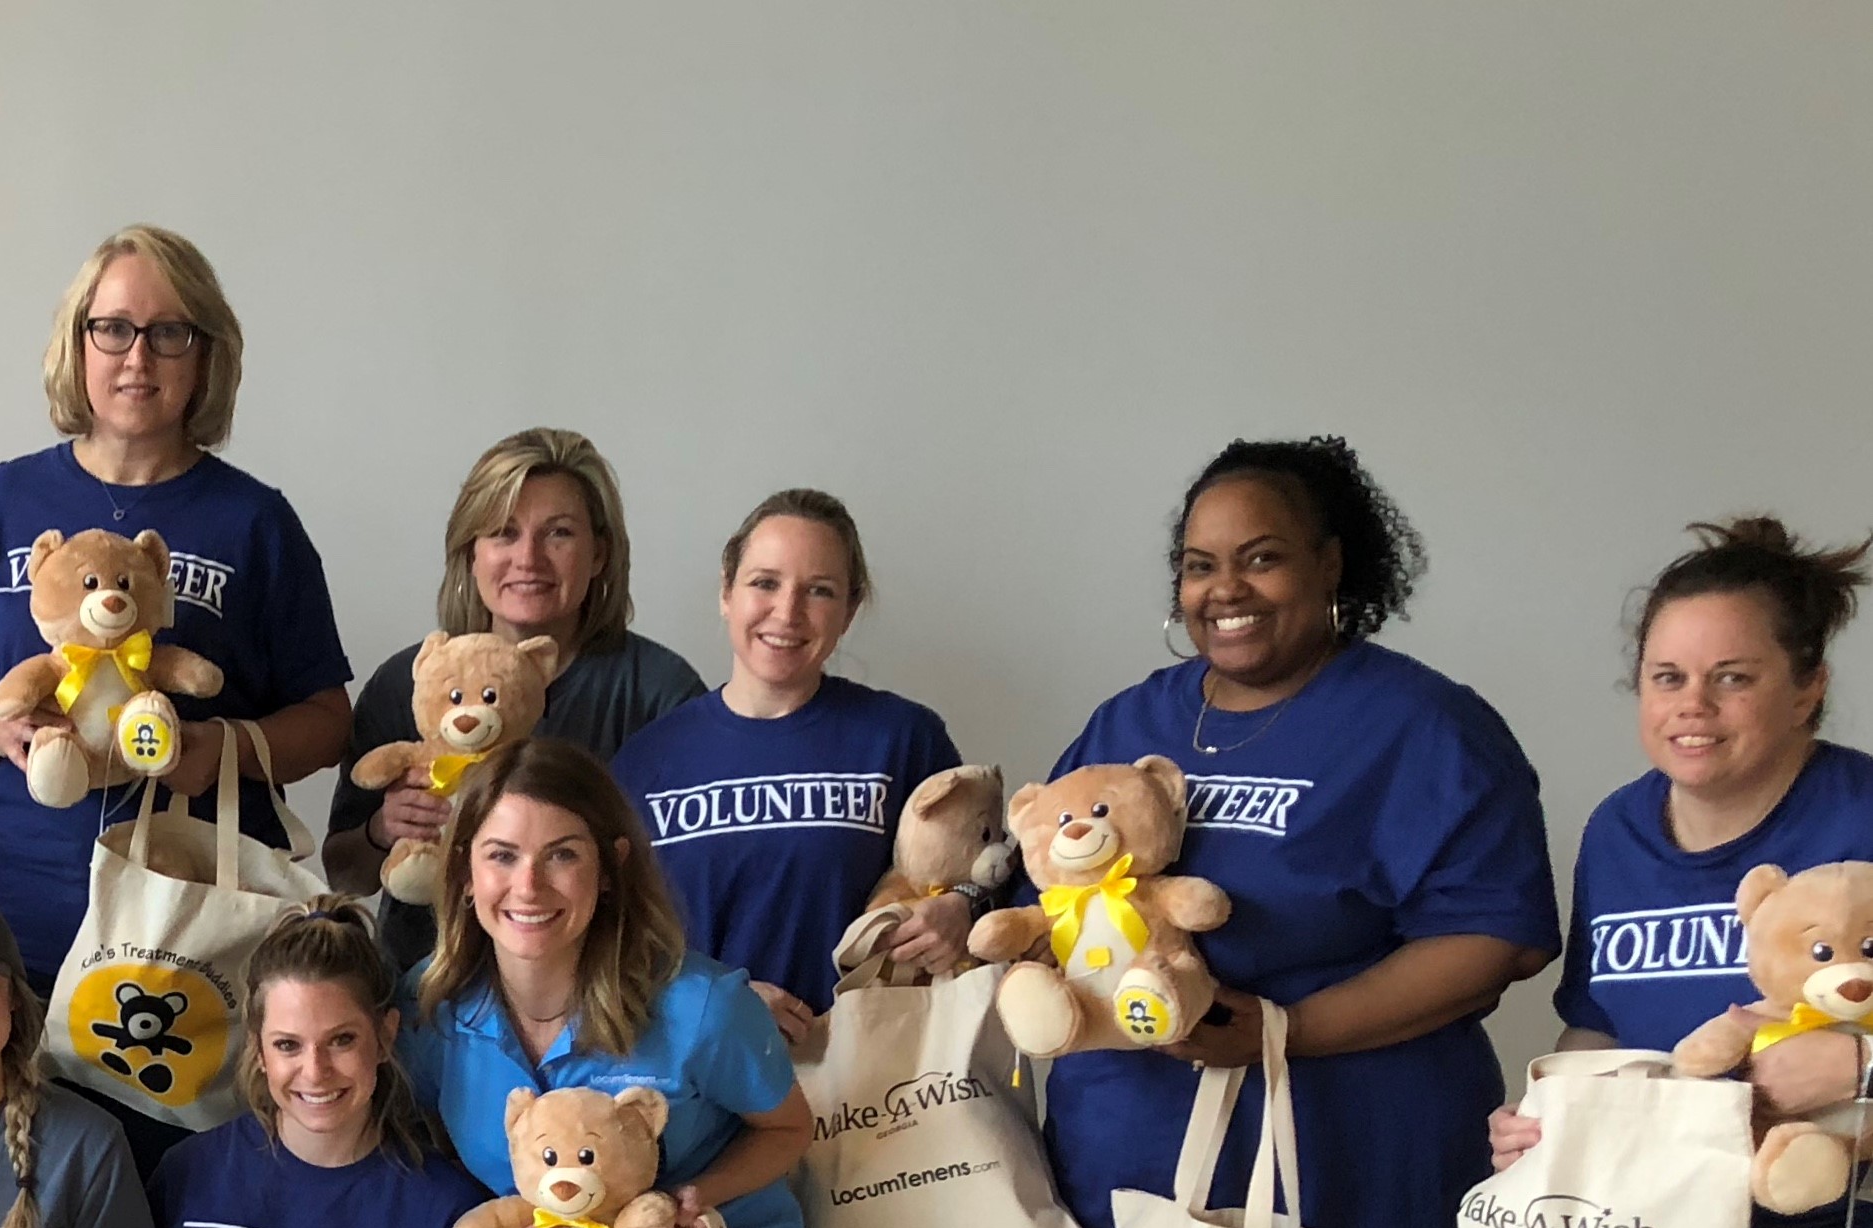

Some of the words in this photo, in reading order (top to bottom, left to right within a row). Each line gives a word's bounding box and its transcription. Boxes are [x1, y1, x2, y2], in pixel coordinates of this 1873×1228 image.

[648, 781, 888, 838] VOLUNTEER
[1591, 914, 1750, 975] VOLUNT
[830, 1160, 1001, 1206] LocumTenens.com
